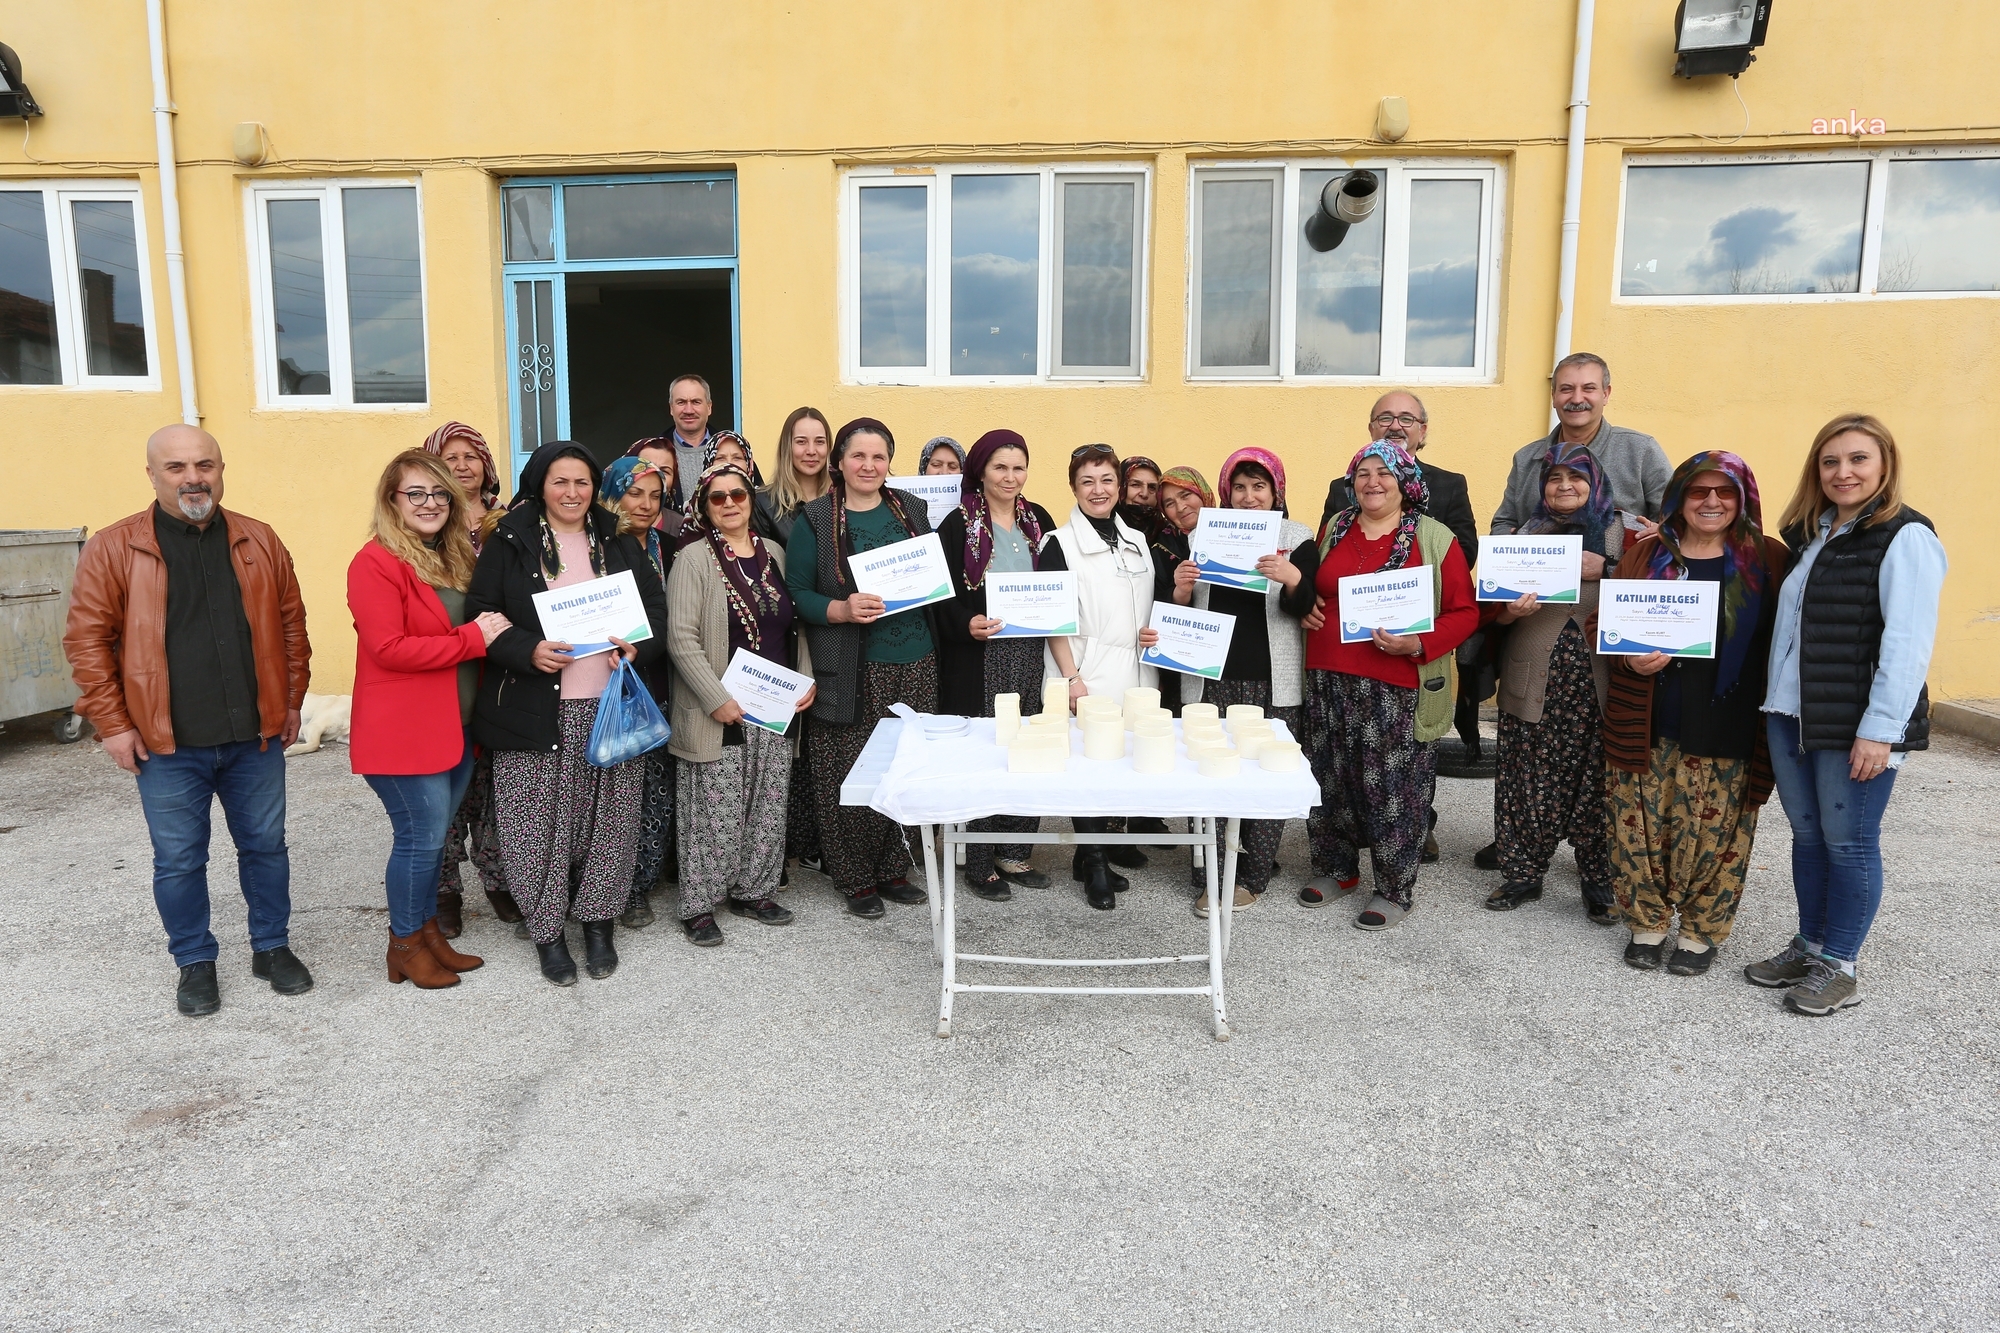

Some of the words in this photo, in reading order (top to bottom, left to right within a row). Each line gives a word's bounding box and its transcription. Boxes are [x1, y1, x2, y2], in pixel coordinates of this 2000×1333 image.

[930, 484, 958, 494] BELGESİ
[1208, 520, 1237, 529] KATILIM
[1238, 522, 1267, 531] BELGESİ
[1531, 545, 1566, 555] BELGESİ
[864, 557, 897, 572] KATILIM
[897, 546, 927, 562] BELGESİ
[1033, 582, 1063, 591] BELGESİ
[1352, 584, 1385, 595] KATILIM
[1387, 578, 1418, 591] BELGESİ
[551, 596, 587, 612] KATILIM
[588, 585, 622, 602] BELGESİ
[1616, 594, 1657, 603] KATILIM
[1660, 593, 1699, 604] BELGESİ
[1162, 615, 1191, 627] KATILIM
[1192, 622, 1220, 633] BELGESİ
[742, 665, 771, 682] KATILIM
[771, 677, 798, 691] BELGESİ
